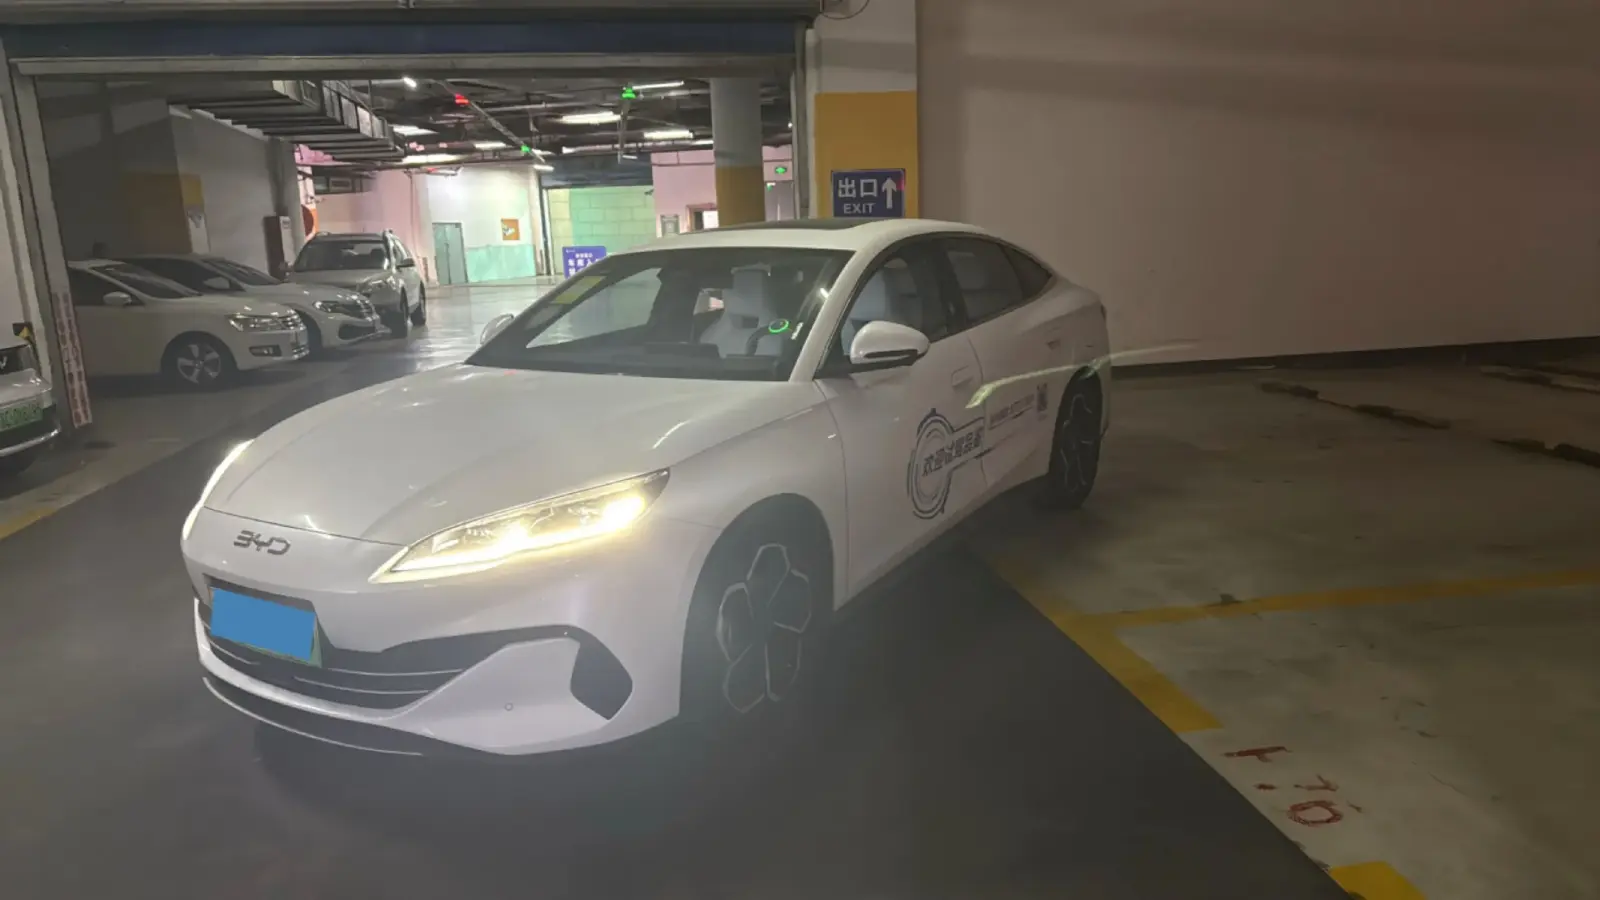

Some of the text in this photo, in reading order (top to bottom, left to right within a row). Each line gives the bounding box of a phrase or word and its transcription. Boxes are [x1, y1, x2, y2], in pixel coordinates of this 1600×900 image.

[838, 177, 877, 198] 出口
[843, 203, 876, 214] EXIT
[233, 529, 291, 555] BYD
